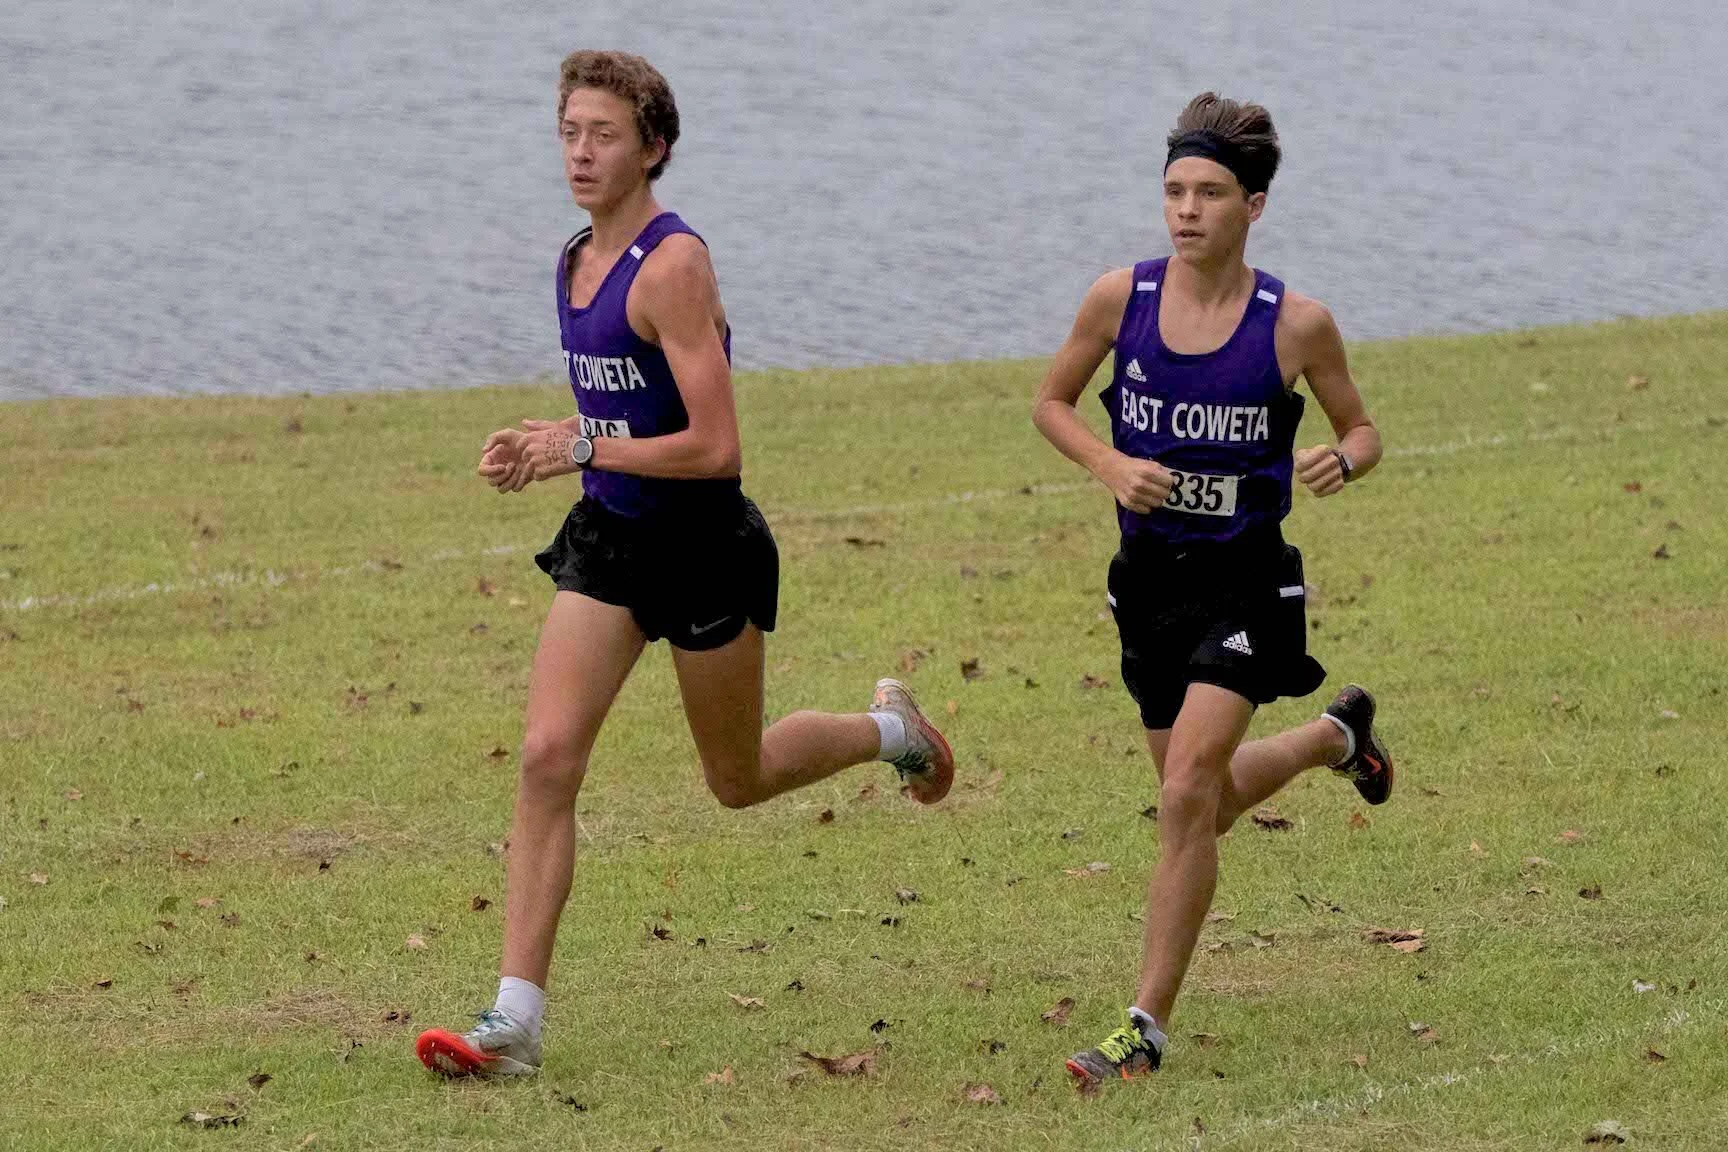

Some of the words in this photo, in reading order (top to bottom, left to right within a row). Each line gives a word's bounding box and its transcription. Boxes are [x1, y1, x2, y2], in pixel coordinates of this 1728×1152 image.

[573, 353, 647, 392] COWETA
[1121, 386, 1163, 433] EAST
[1171, 402, 1269, 442] COWETA
[1222, 640, 1253, 656] adidas
